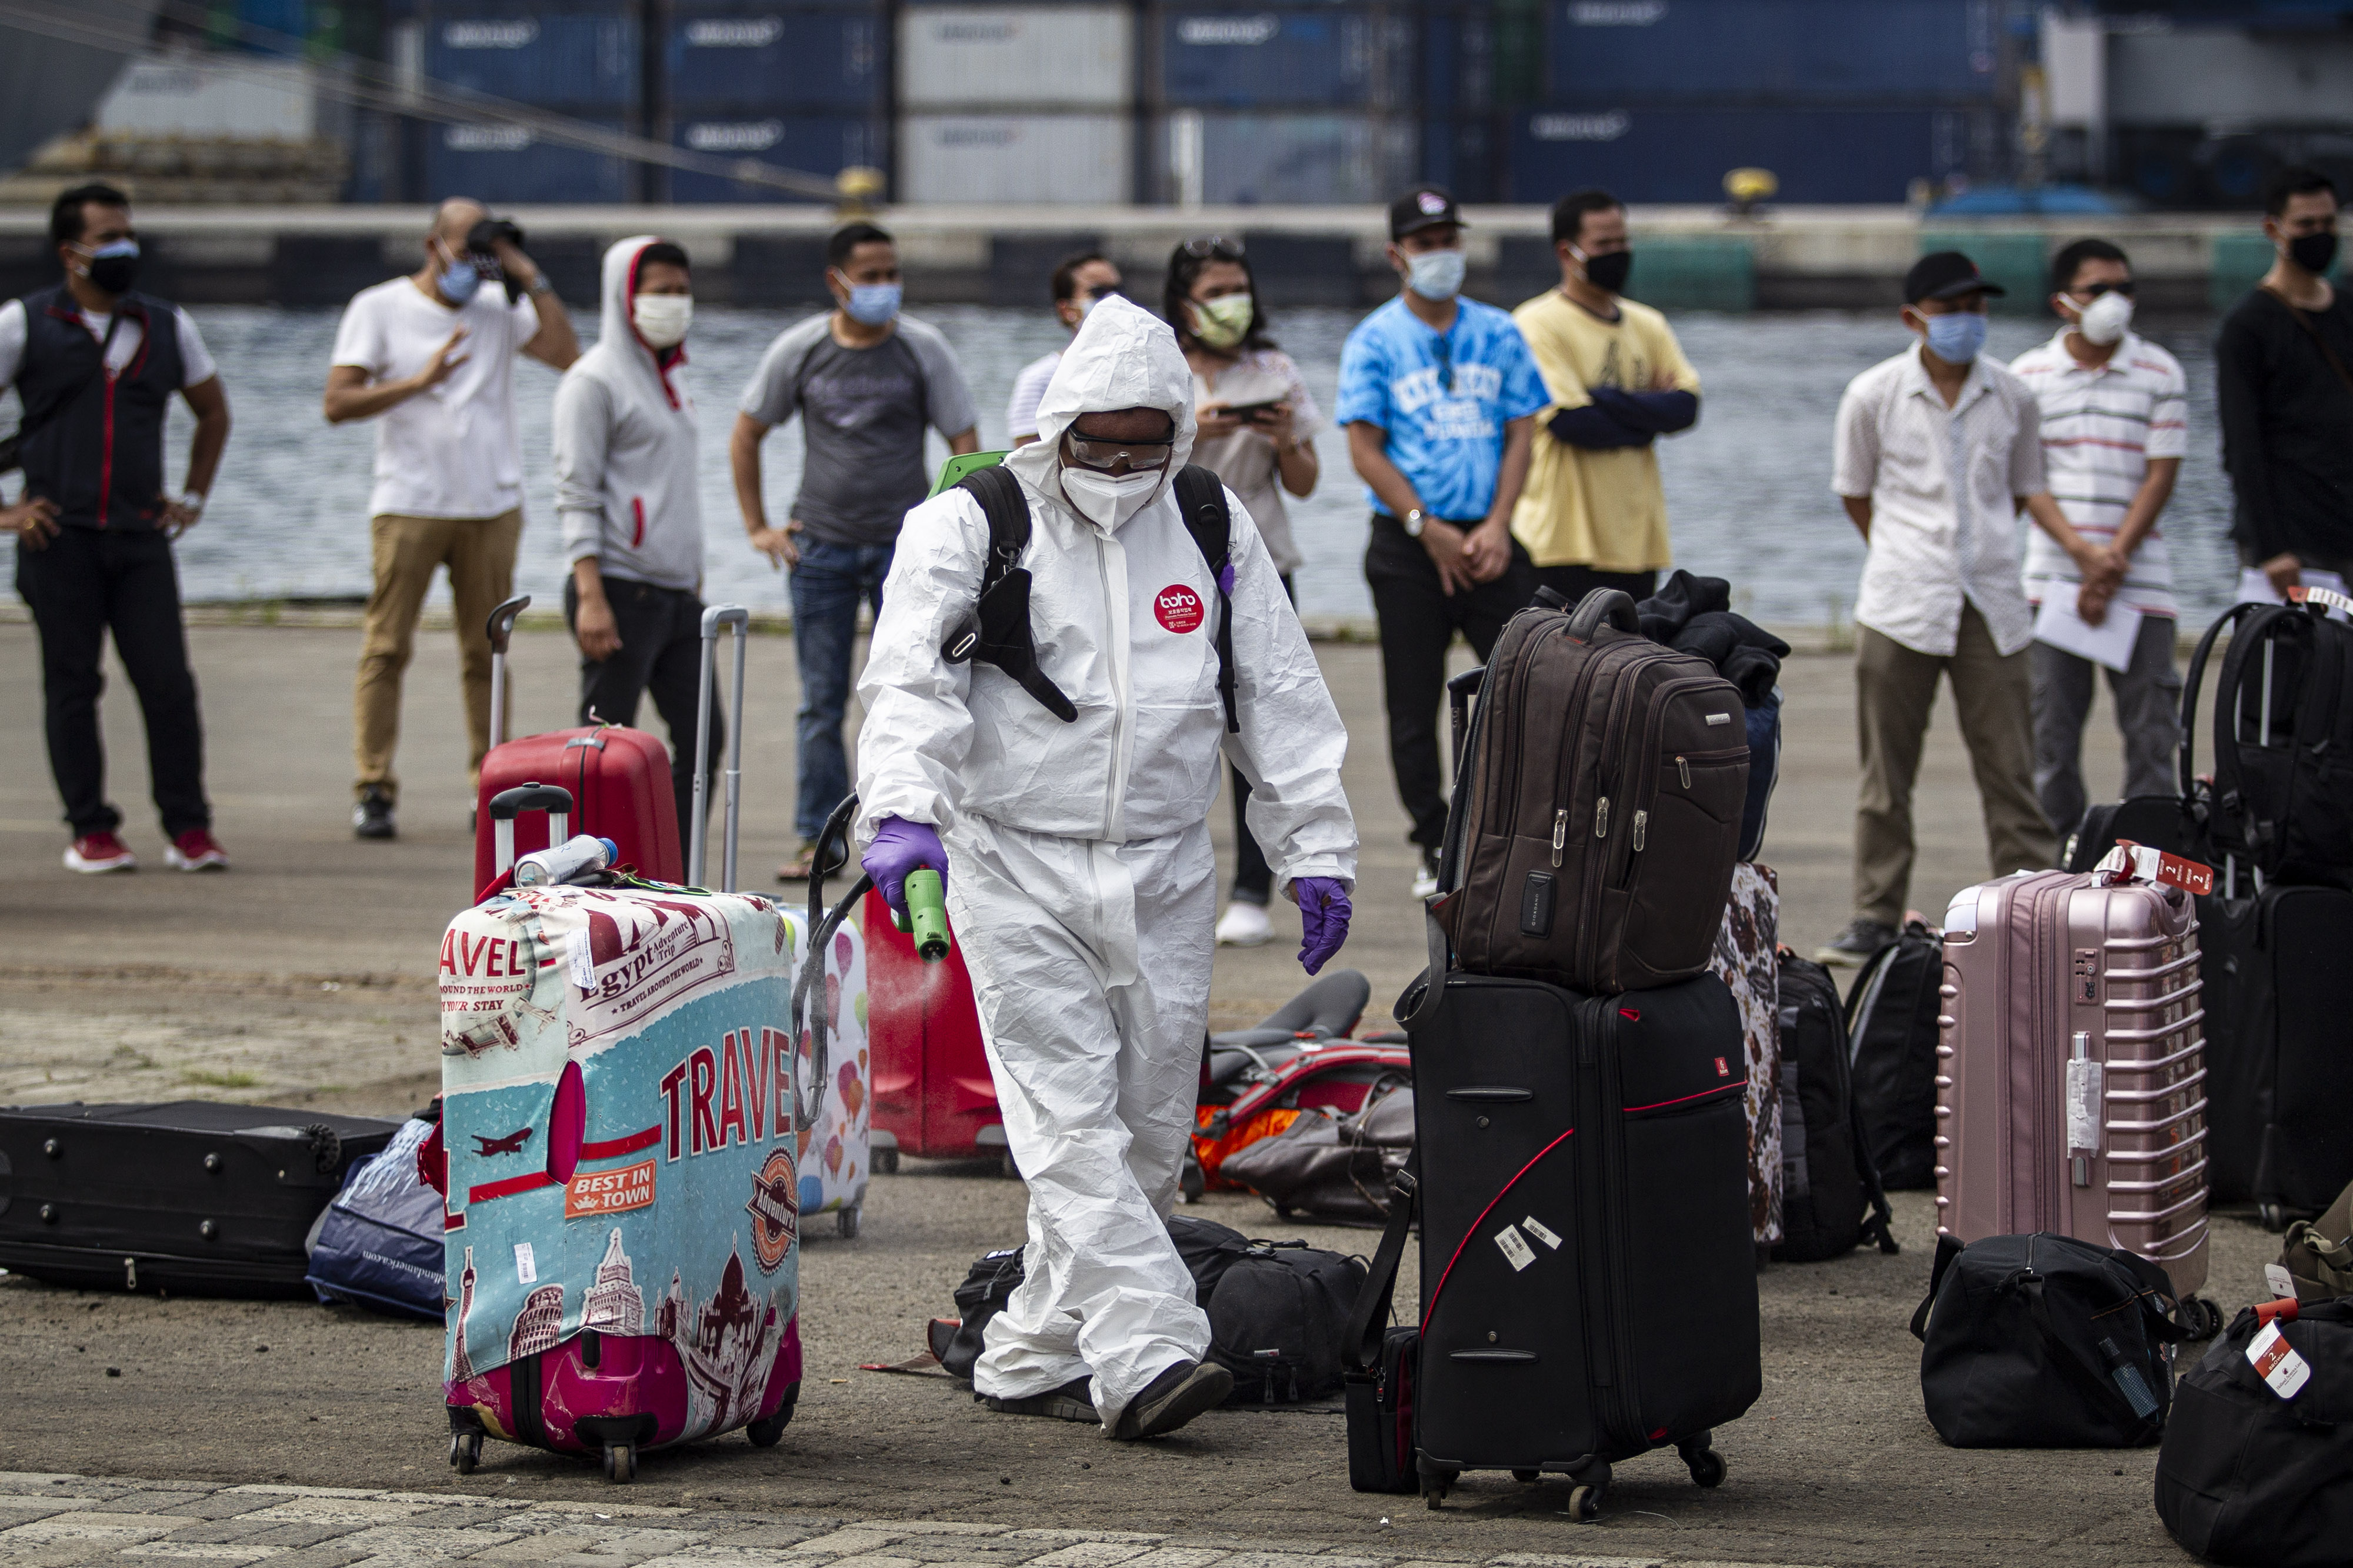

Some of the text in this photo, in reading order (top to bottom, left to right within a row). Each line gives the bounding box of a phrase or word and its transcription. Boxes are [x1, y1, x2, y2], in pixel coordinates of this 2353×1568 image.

[1159, 592, 1196, 609] boho
[2165, 866, 2176, 875] 2
[2193, 875, 2204, 883] 2
[653, 920, 689, 953] Adventure
[658, 944, 676, 961] Trip
[487, 983, 524, 993] WORLD
[620, 958, 700, 1012] TRAVEL AROUND THE WORLD
[447, 1001, 468, 1012] YOUR
[473, 1000, 505, 1011] STAY
[659, 1025, 798, 1163] TRAVE
[574, 1166, 651, 1194] BEST IN
[602, 1185, 649, 1207] TOWN
[757, 1187, 795, 1229] Adventure
[2268, 1352, 2277, 1362] 2
[2268, 1352, 2285, 1370] BROWN
